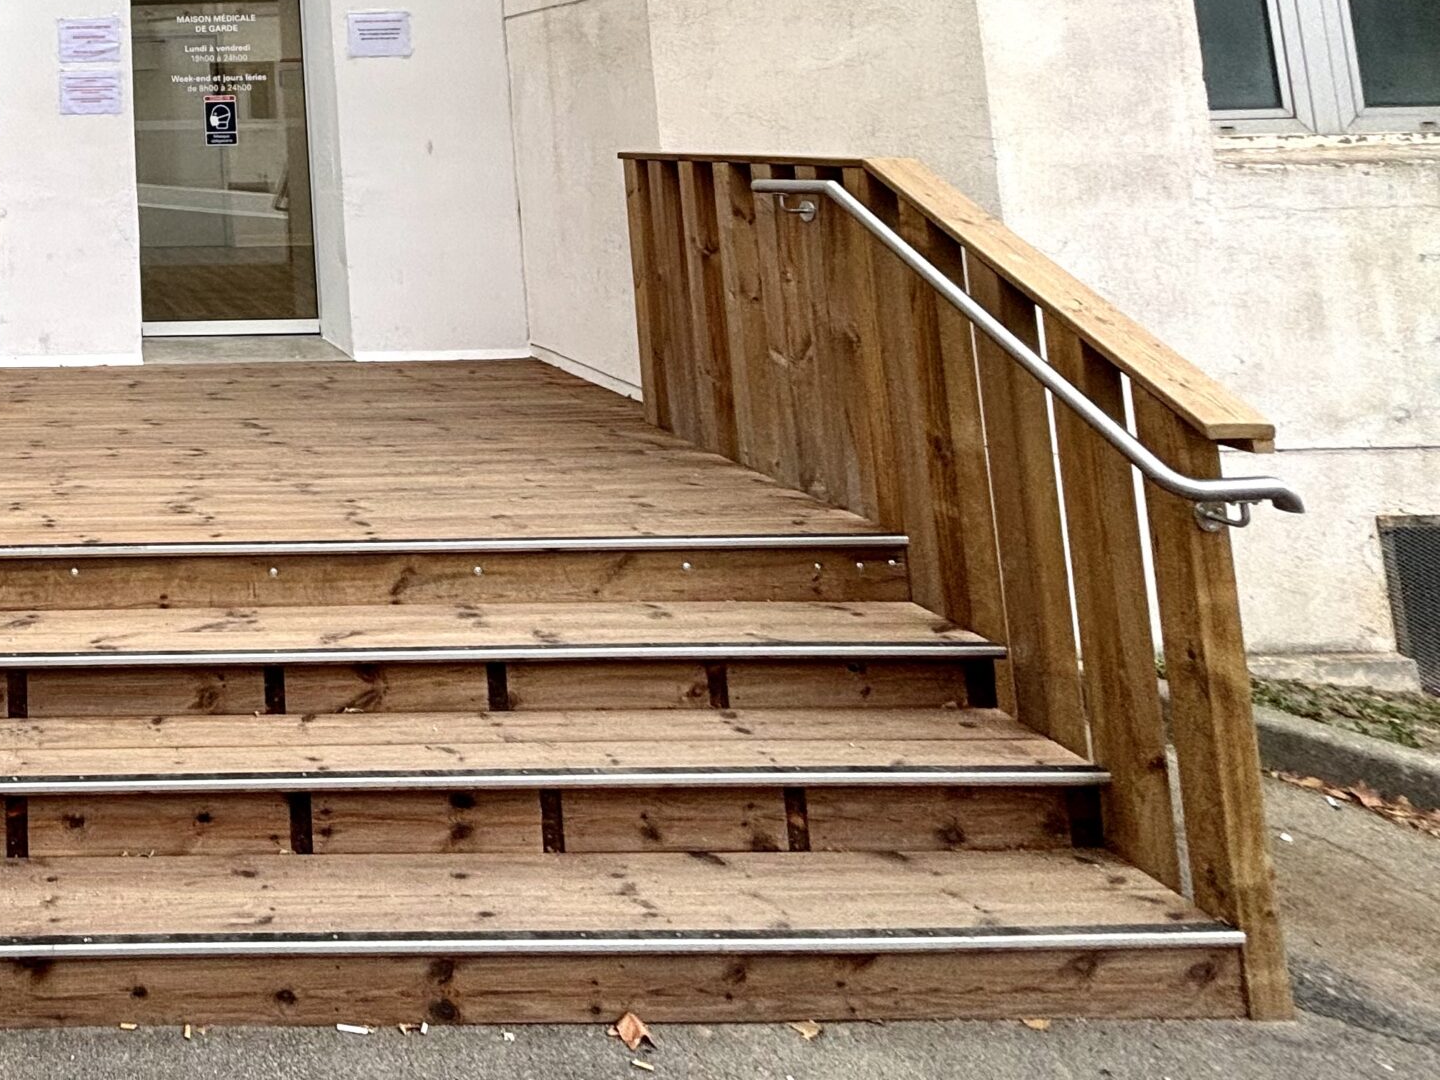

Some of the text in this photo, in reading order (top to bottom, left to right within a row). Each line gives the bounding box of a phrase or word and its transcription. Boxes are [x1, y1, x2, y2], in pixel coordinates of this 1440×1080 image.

[176, 13, 256, 24] MAISON MÉDICALE
[195, 24, 238, 33] DE GARDE
[184, 45, 207, 53] Lundi
[216, 44, 251, 52] vendredi
[171, 74, 210, 83] Week-end
[223, 74, 243, 84] jours
[187, 84, 197, 92] de
[227, 83, 252, 91] 24h00
